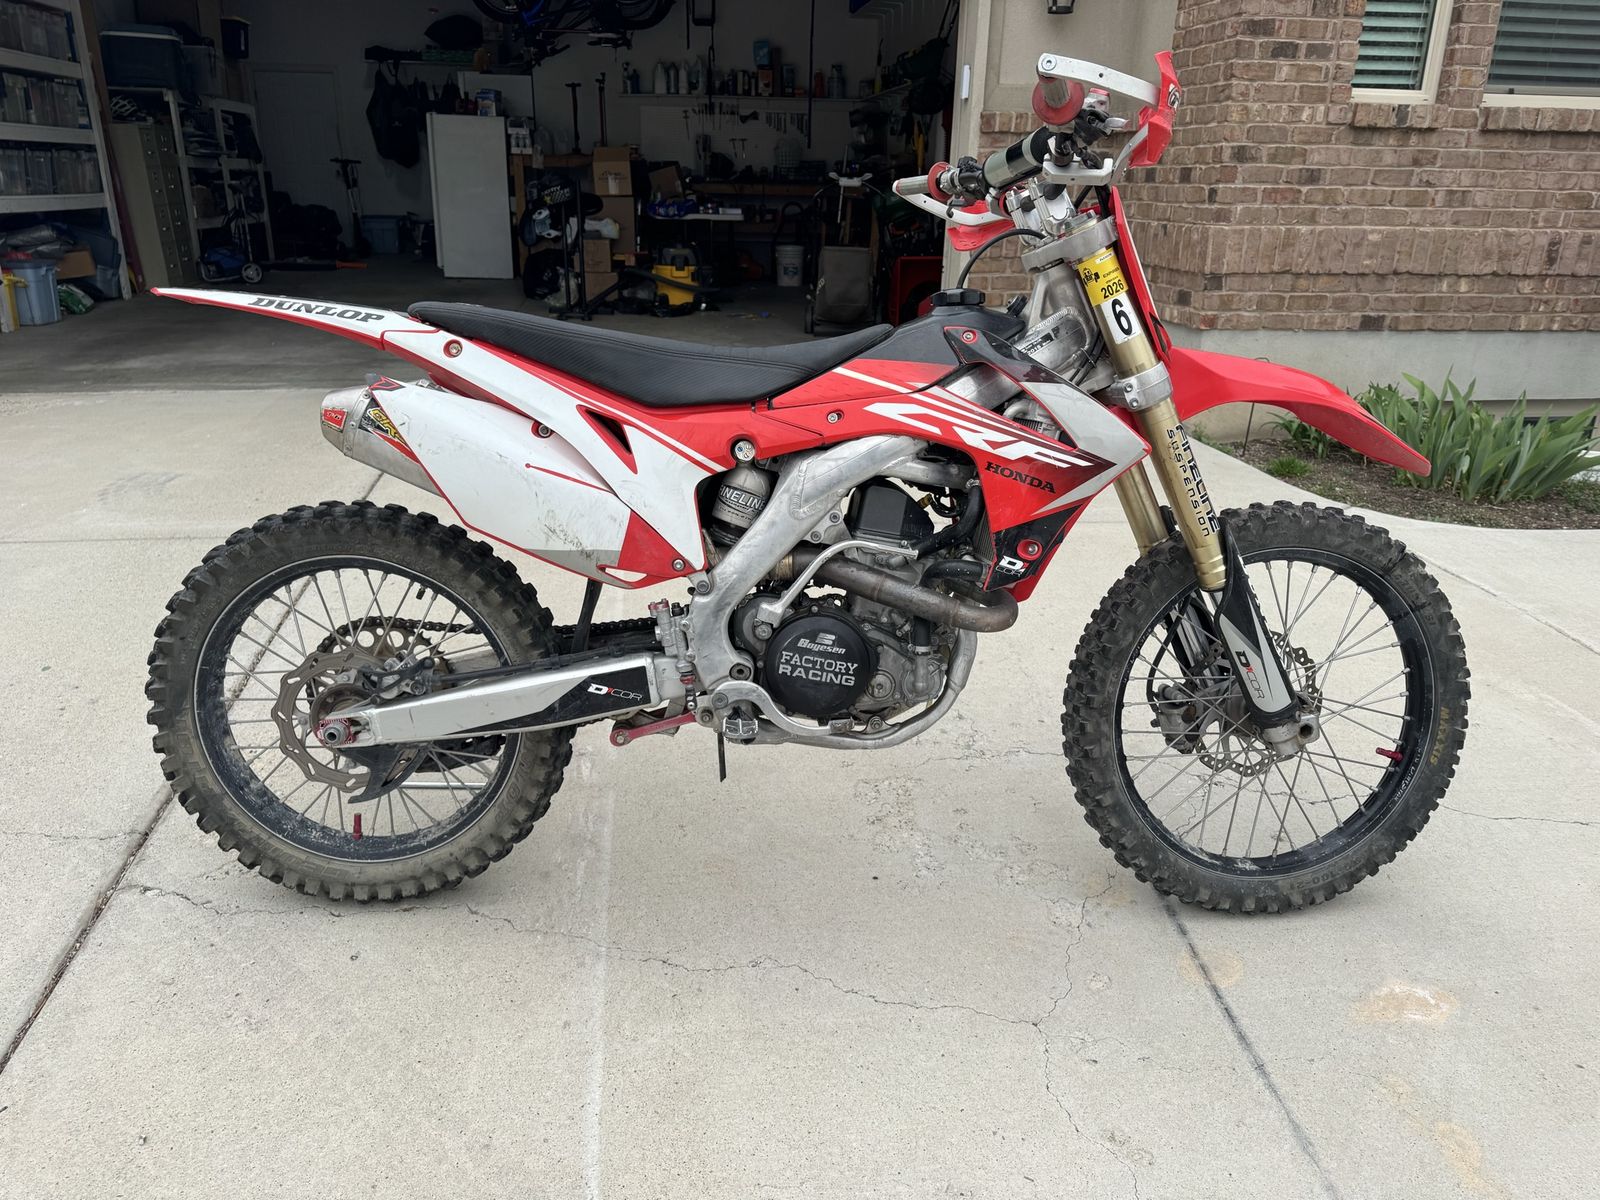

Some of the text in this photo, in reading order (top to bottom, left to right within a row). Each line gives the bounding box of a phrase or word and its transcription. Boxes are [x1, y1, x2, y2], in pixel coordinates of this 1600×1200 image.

[1101, 279, 1125, 299] 2026
[247, 297, 385, 322] DUNLOP
[1111, 298, 1133, 336] 6
[984, 461, 1056, 494] HONDA
[797, 637, 846, 655] Boyesen
[780, 651, 858, 675] FACTORY
[778, 664, 856, 687] RACING
[1430, 707, 1449, 765] MAXXIS
